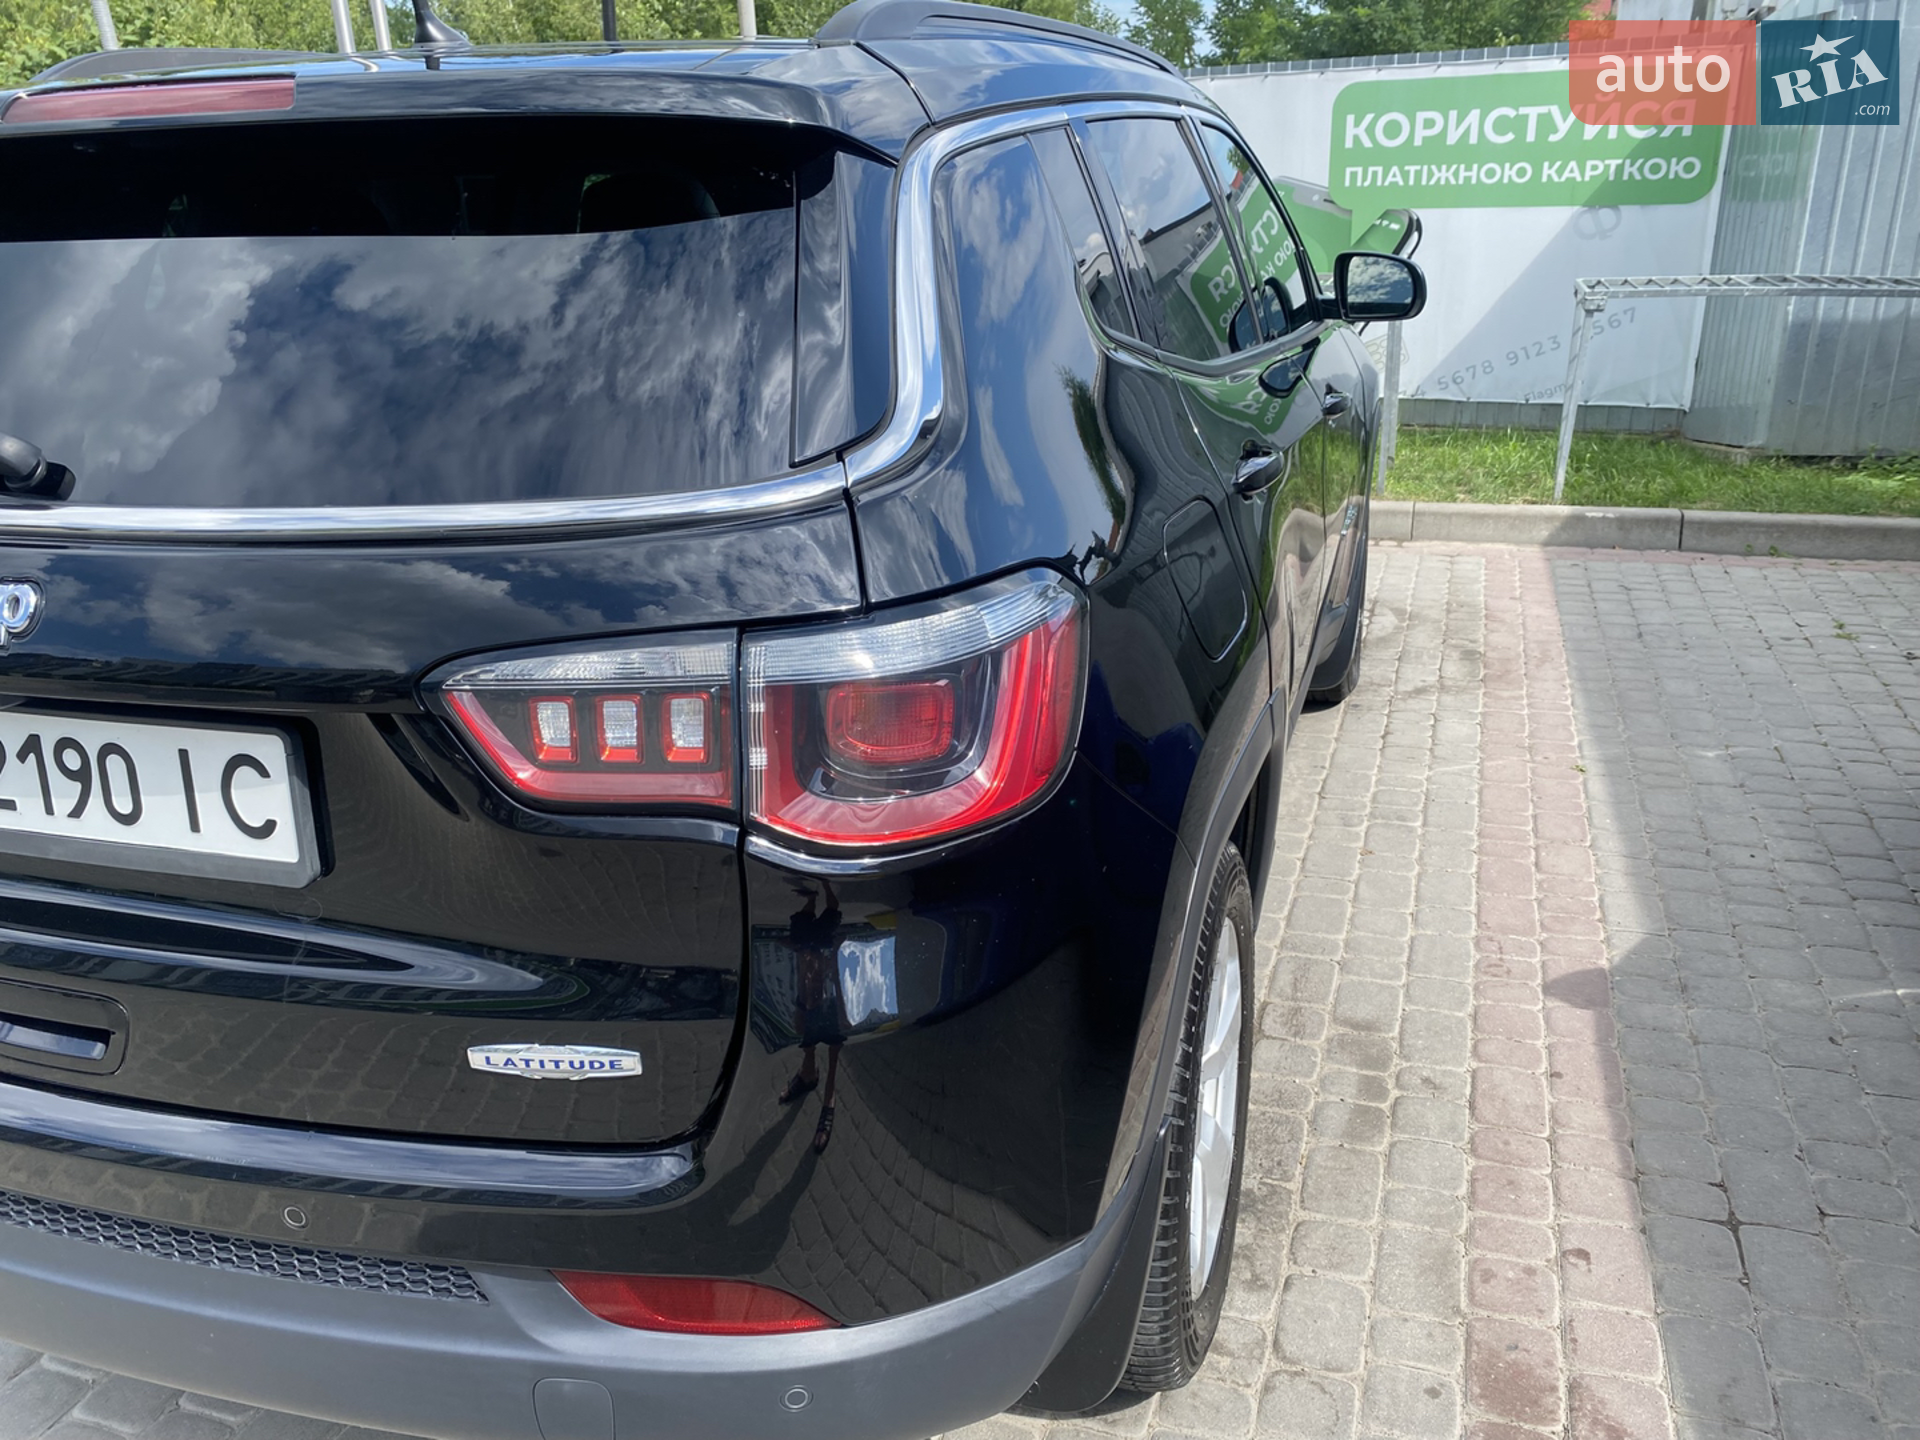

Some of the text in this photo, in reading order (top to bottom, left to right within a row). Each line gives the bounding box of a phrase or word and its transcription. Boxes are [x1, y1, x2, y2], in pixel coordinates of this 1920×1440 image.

[1343, 93, 1696, 149] КОРИСТУЙСЯ
[1343, 156, 1702, 188] ПЛАТІЖНОЮ КАРТКОЮ
[1437, 359, 1495, 391] 5678
[1505, 335, 1561, 366] 9123
[1589, 306, 1637, 336] 567
[484, 1055, 624, 1071] LATITUDE
